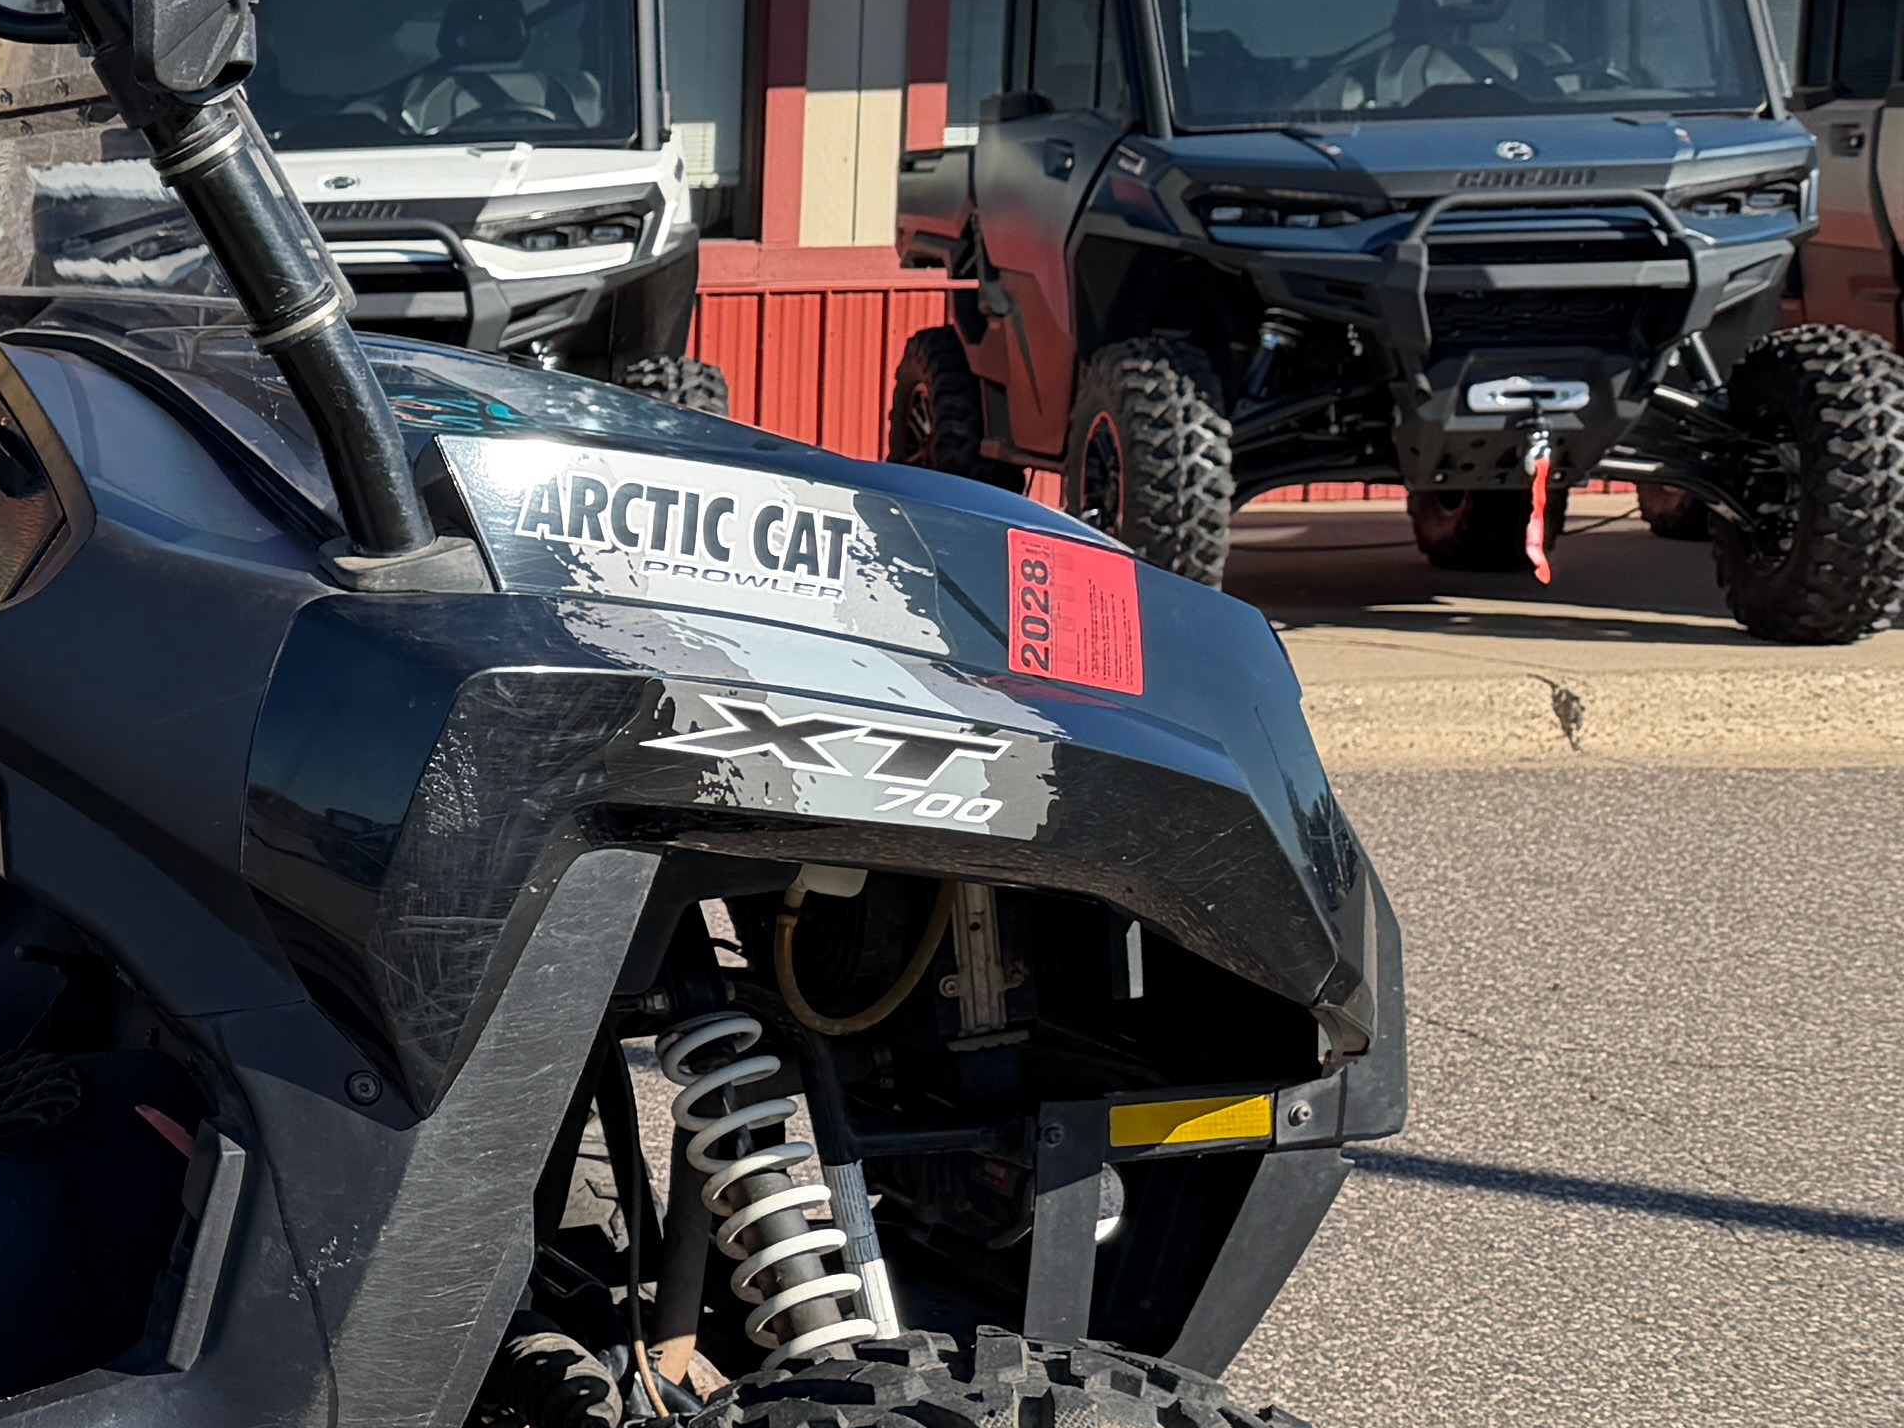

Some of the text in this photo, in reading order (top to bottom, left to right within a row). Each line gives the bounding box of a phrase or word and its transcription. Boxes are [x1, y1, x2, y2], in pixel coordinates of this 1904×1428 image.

[517, 471, 856, 581] ARCTIC CAT
[643, 560, 844, 600] PROWLER
[1020, 558, 1051, 672] 2028
[641, 693, 1012, 786] XT
[876, 783, 1002, 823] 700
